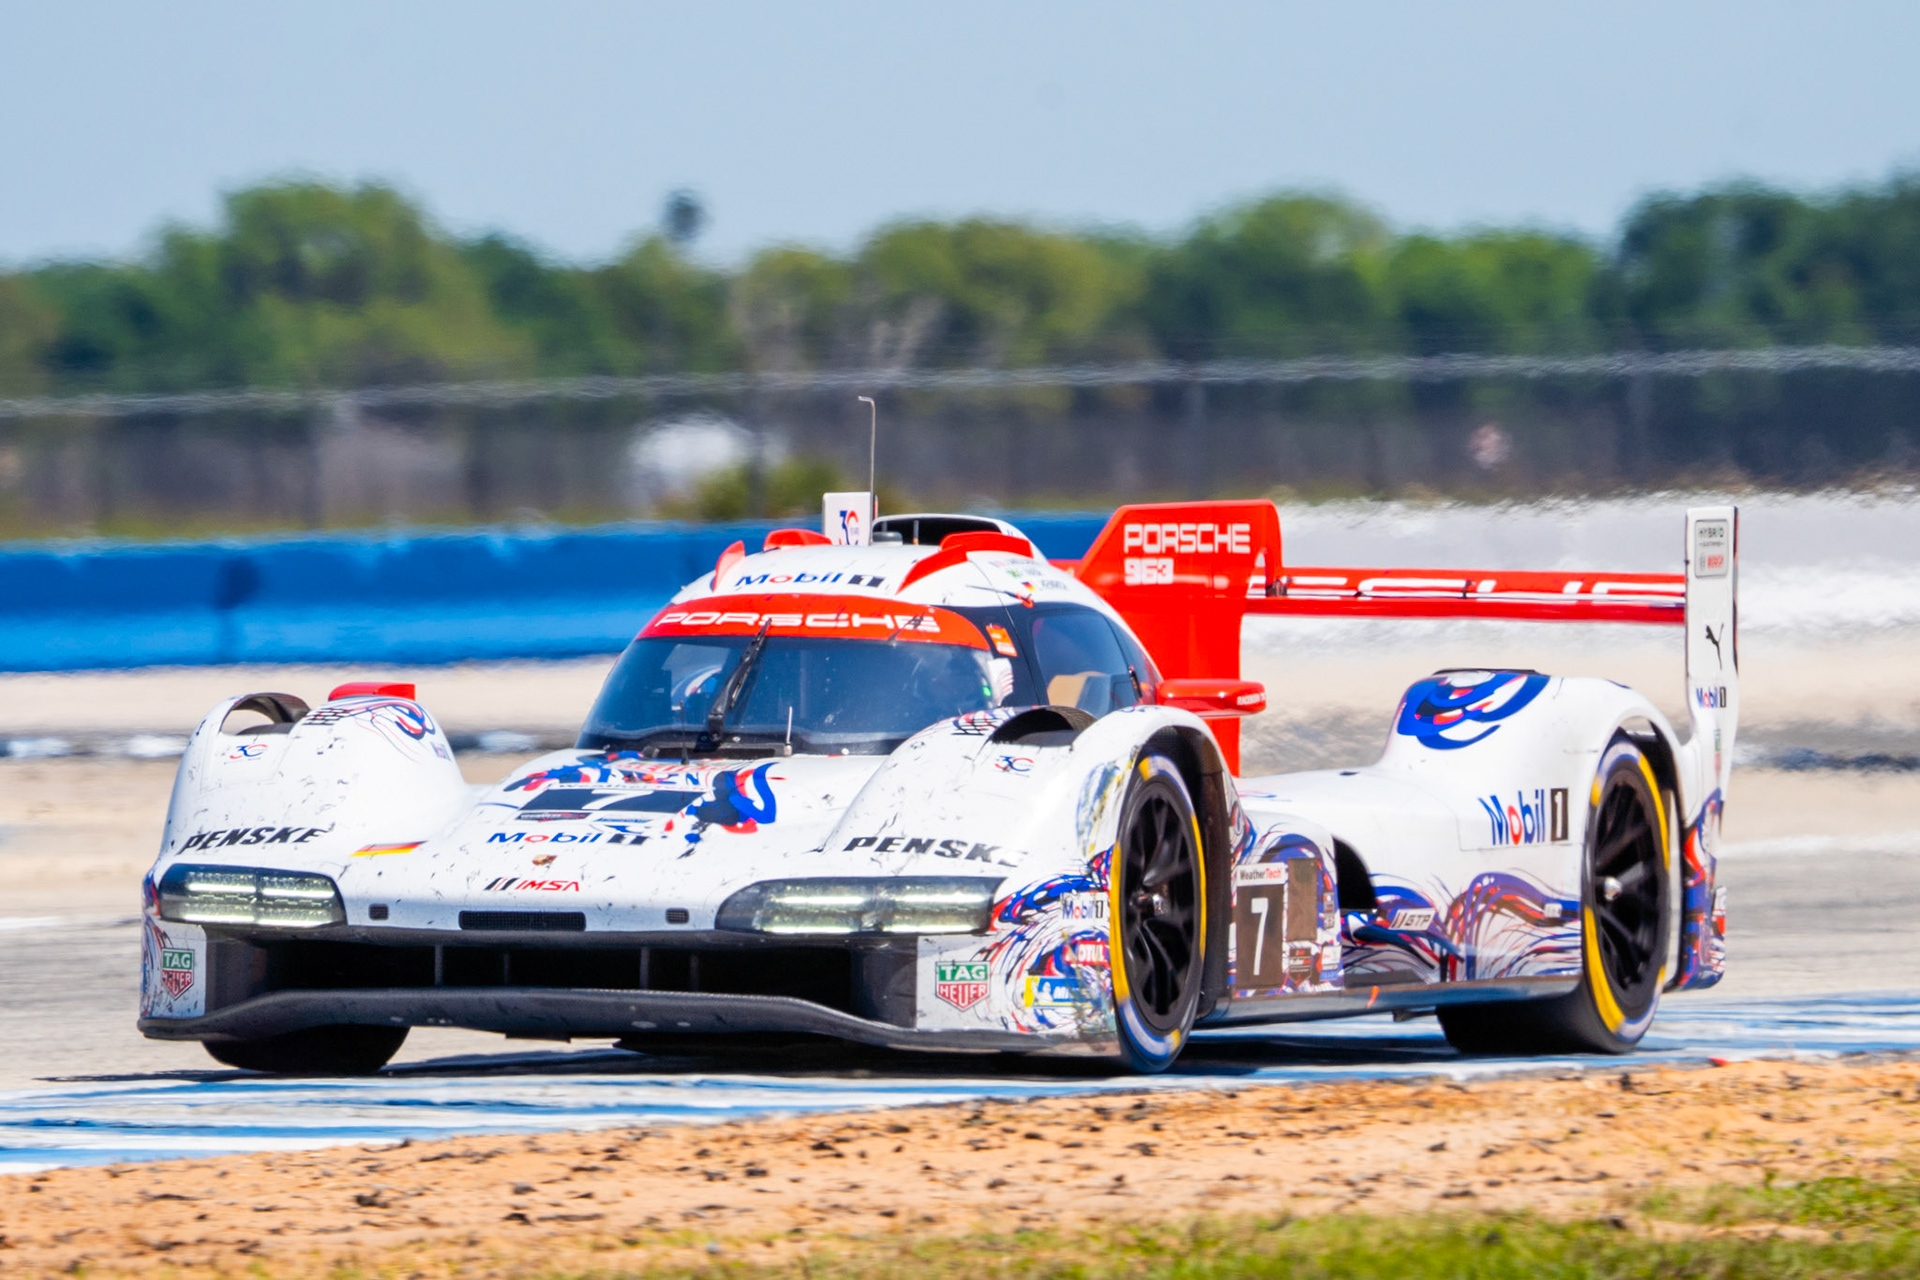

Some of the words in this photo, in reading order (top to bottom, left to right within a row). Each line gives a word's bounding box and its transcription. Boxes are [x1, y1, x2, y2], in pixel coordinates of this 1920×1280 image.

[1124, 523, 1250, 554] PORSCHE
[735, 573, 844, 587] Mobil
[848, 574, 885, 588] 1
[1124, 558, 1174, 585] 963
[655, 612, 941, 633] PORSCHE
[1696, 686, 1718, 708] Mobil
[581, 789, 655, 811] 7
[1478, 789, 1545, 846] Mobil
[1551, 788, 1568, 842] 1
[175, 826, 329, 856] PENSKE
[487, 832, 603, 844] Mobil
[606, 833, 650, 846] 1
[1239, 867, 1282, 880] WeatherTech
[514, 879, 580, 892] IMSA
[1062, 899, 1095, 920] Mobil
[1404, 914, 1432, 927] GTP
[1251, 897, 1269, 976] 7
[164, 952, 191, 969] TAG
[162, 971, 191, 994] HEUER
[941, 965, 986, 981] TAG
[940, 984, 987, 1006] HEUER
